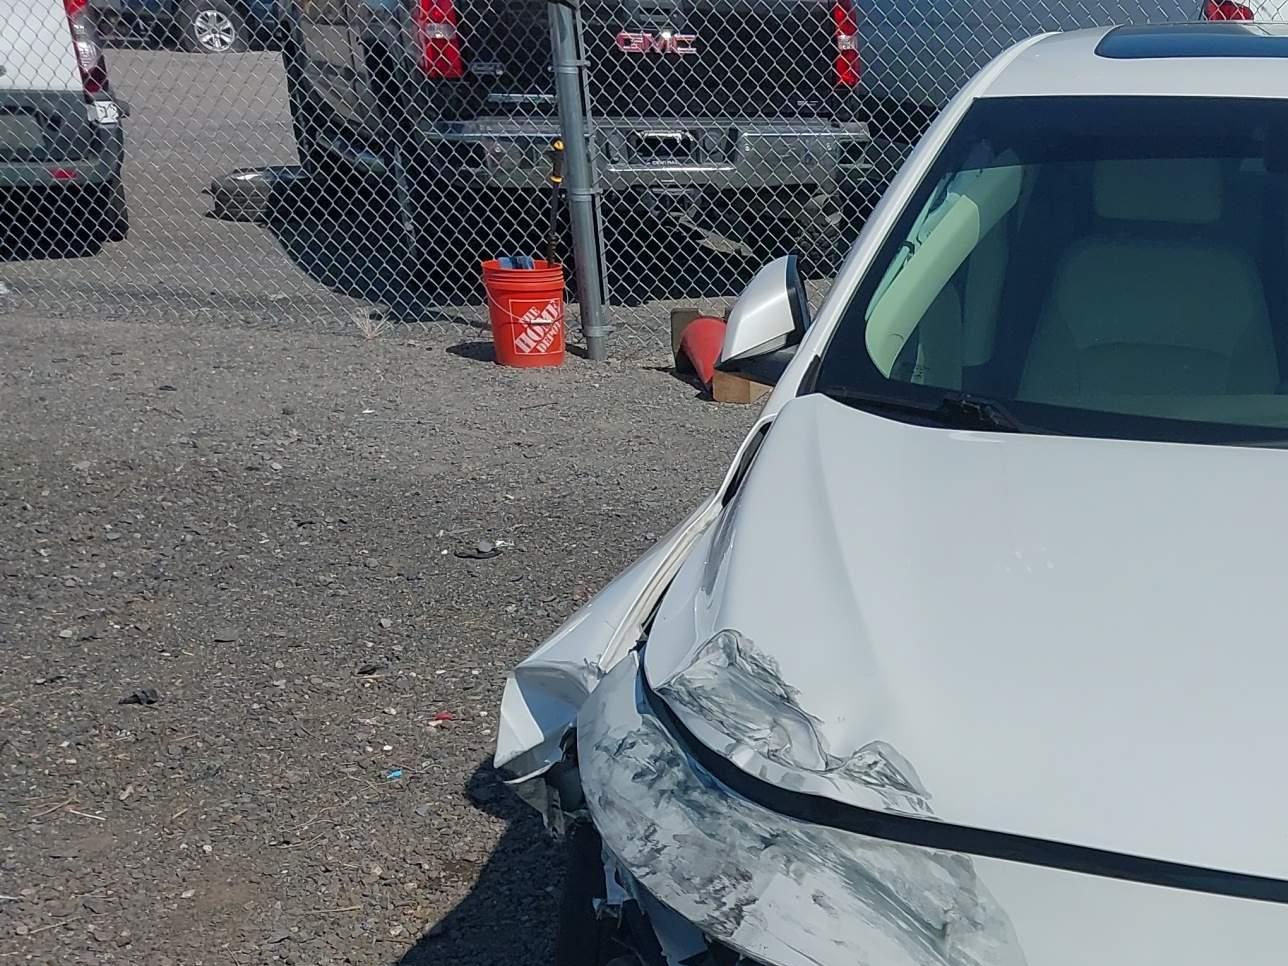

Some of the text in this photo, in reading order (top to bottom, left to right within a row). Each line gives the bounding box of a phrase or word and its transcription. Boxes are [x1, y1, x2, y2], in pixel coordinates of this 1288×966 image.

[615, 32, 697, 53] GMC
[515, 300, 559, 353] HOME
[519, 306, 540, 328] THE
[536, 321, 561, 352] DEPOT
